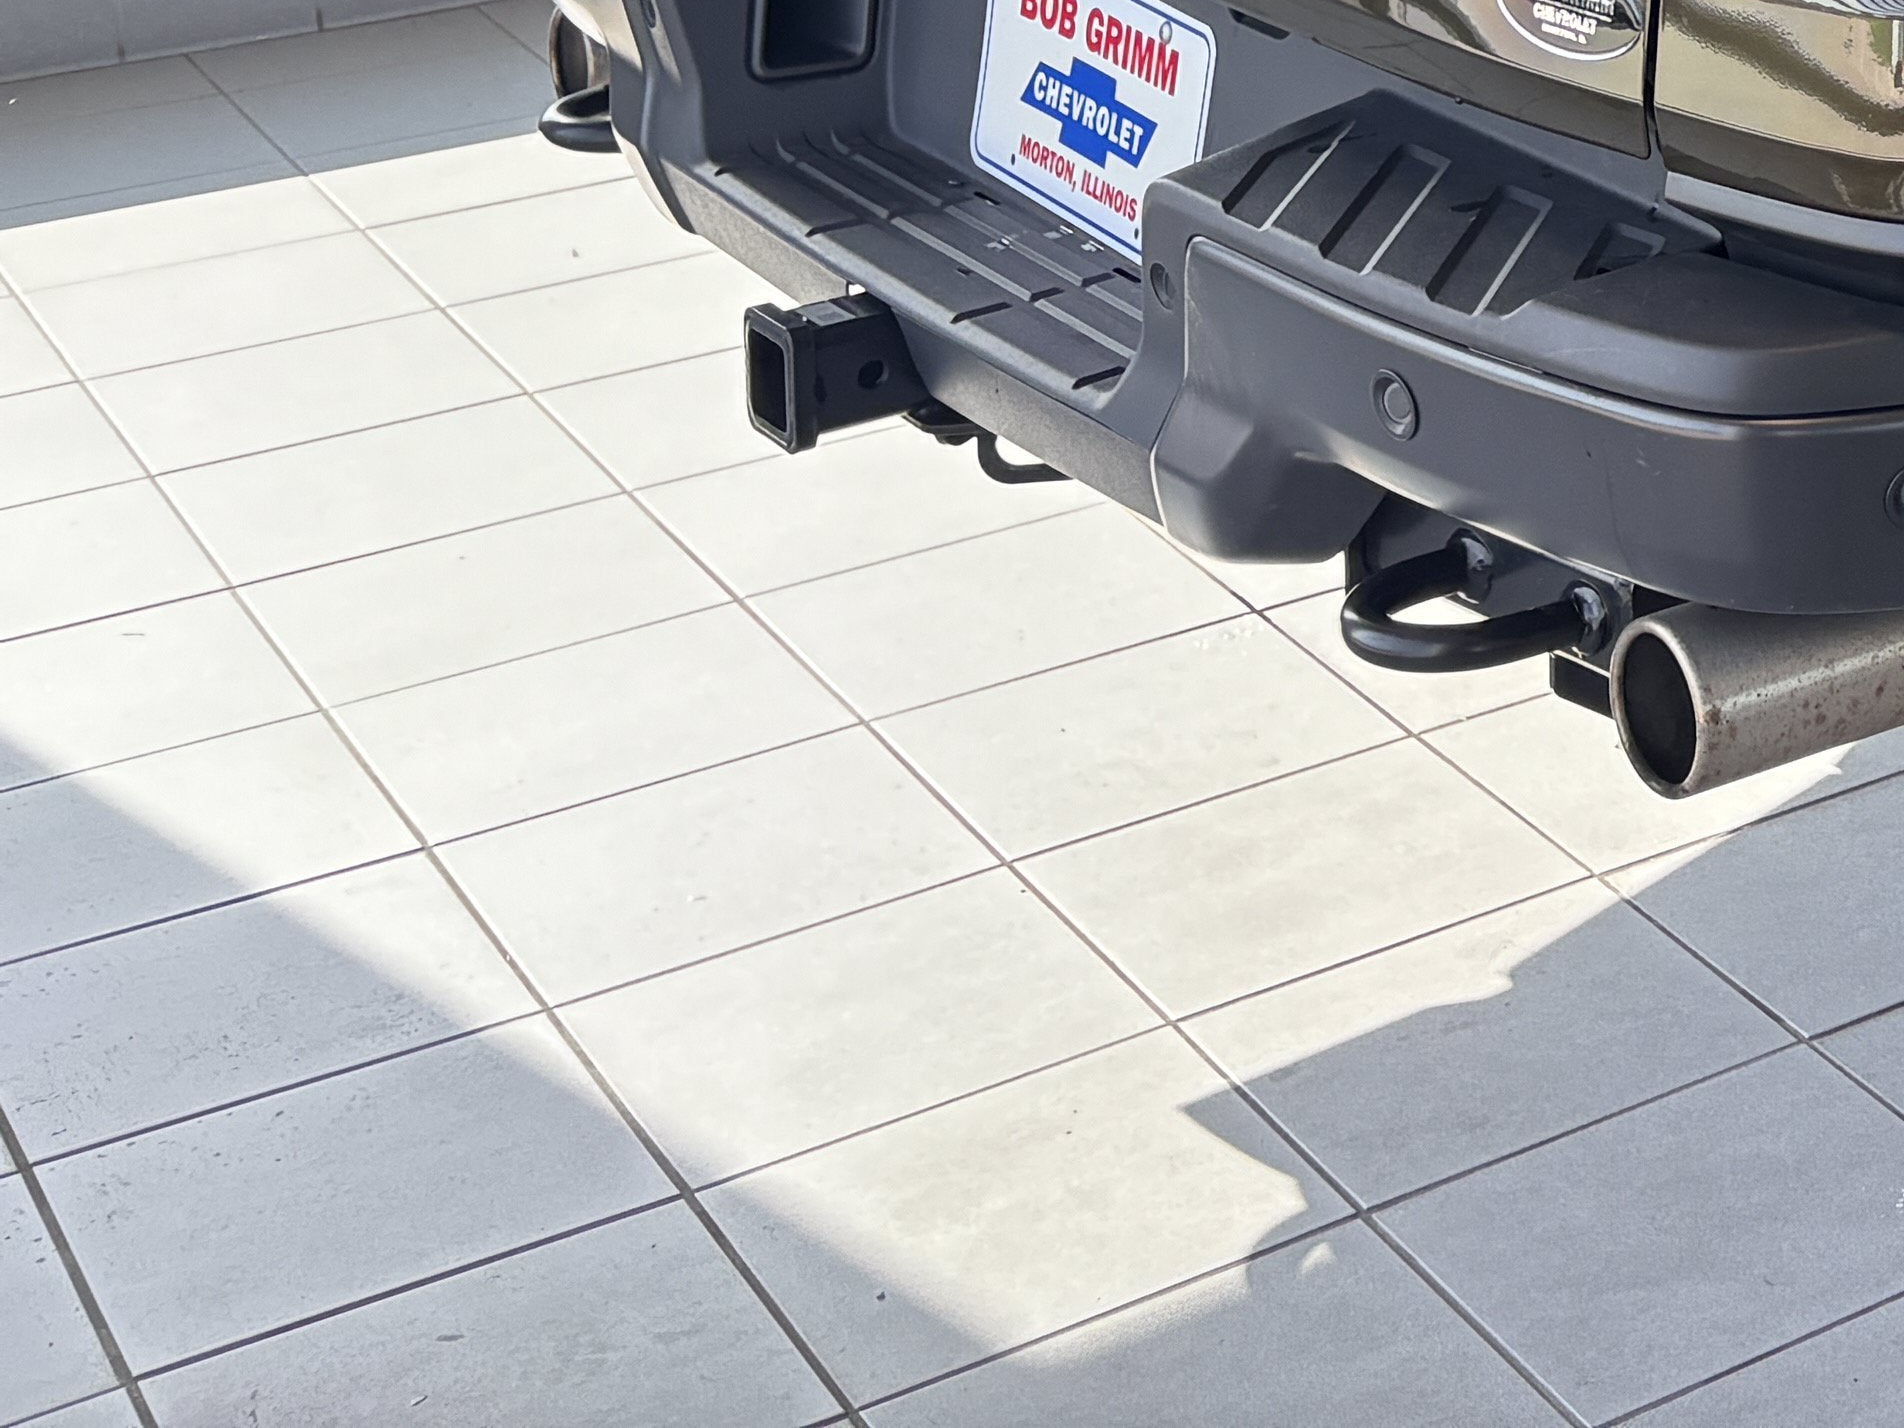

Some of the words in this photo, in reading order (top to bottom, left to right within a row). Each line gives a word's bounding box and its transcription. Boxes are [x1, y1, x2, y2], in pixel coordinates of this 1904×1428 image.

[1085, 7, 1180, 97] GRIMM
[1533, 1, 1597, 36] CHEVROLET
[1033, 71, 1144, 156] CHEVROLET
[1018, 134, 1078, 193] MORTON,
[1081, 170, 1138, 223] ILLINOIS
